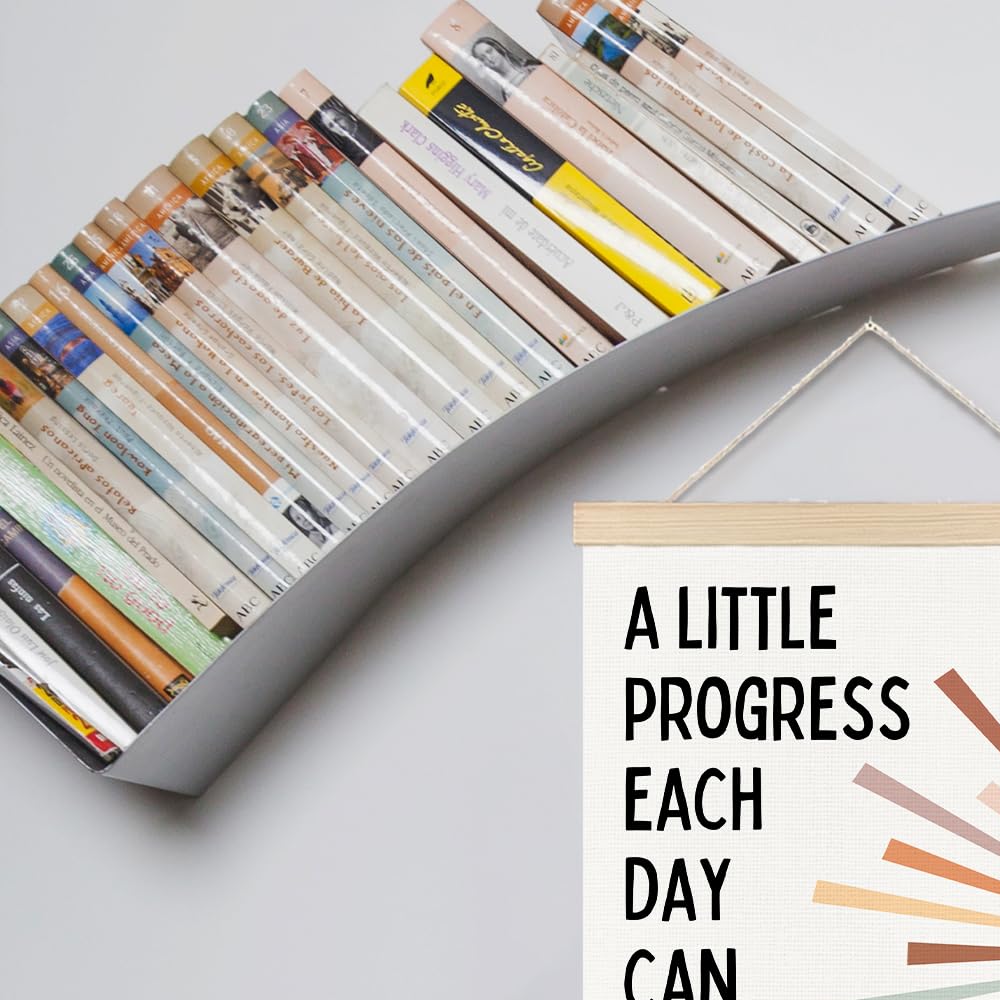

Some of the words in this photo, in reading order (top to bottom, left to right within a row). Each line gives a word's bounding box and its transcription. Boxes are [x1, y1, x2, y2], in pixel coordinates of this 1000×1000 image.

[255, 101, 273, 119] 23
[450, 98, 503, 146] Christie
[705, 113, 726, 133] los
[396, 118, 429, 149] Clark
[724, 127, 742, 143] de
[422, 137, 468, 180] Higgins
[494, 131, 546, 178] Agatha
[739, 139, 777, 170] Costa
[460, 169, 494, 201] Mary
[775, 165, 794, 182] La
[340, 187, 387, 229] nieves
[903, 198, 933, 226] ABC
[381, 225, 407, 251] las
[404, 245, 424, 265] de
[311, 272, 328, 289] de
[447, 286, 466, 304] el
[347, 306, 367, 326] La
[461, 299, 483, 320] En
[191, 297, 253, 354] cachorros
[148, 339, 182, 372] Meca
[250, 350, 274, 373] Los
[72, 402, 104, 433] Tong
[204, 391, 286, 466] peregrinación
[307, 403, 332, 426] Los
[37, 422, 96, 477] africanos
[91, 473, 138, 517] Relatos
[82, 495, 95, 508] en
[101, 512, 129, 538] Museo
[125, 534, 141, 549] del
[136, 544, 163, 569] Prado
[4, 577, 35, 606] ninfas
[30, 602, 51, 622] Las
[233, 593, 261, 622] ABC
[624, 586, 659, 650] A
[678, 585, 837, 650] LITTLE
[625, 675, 910, 741] PROGRESS
[625, 767, 762, 831] EACH
[625, 857, 731, 922] DAY
